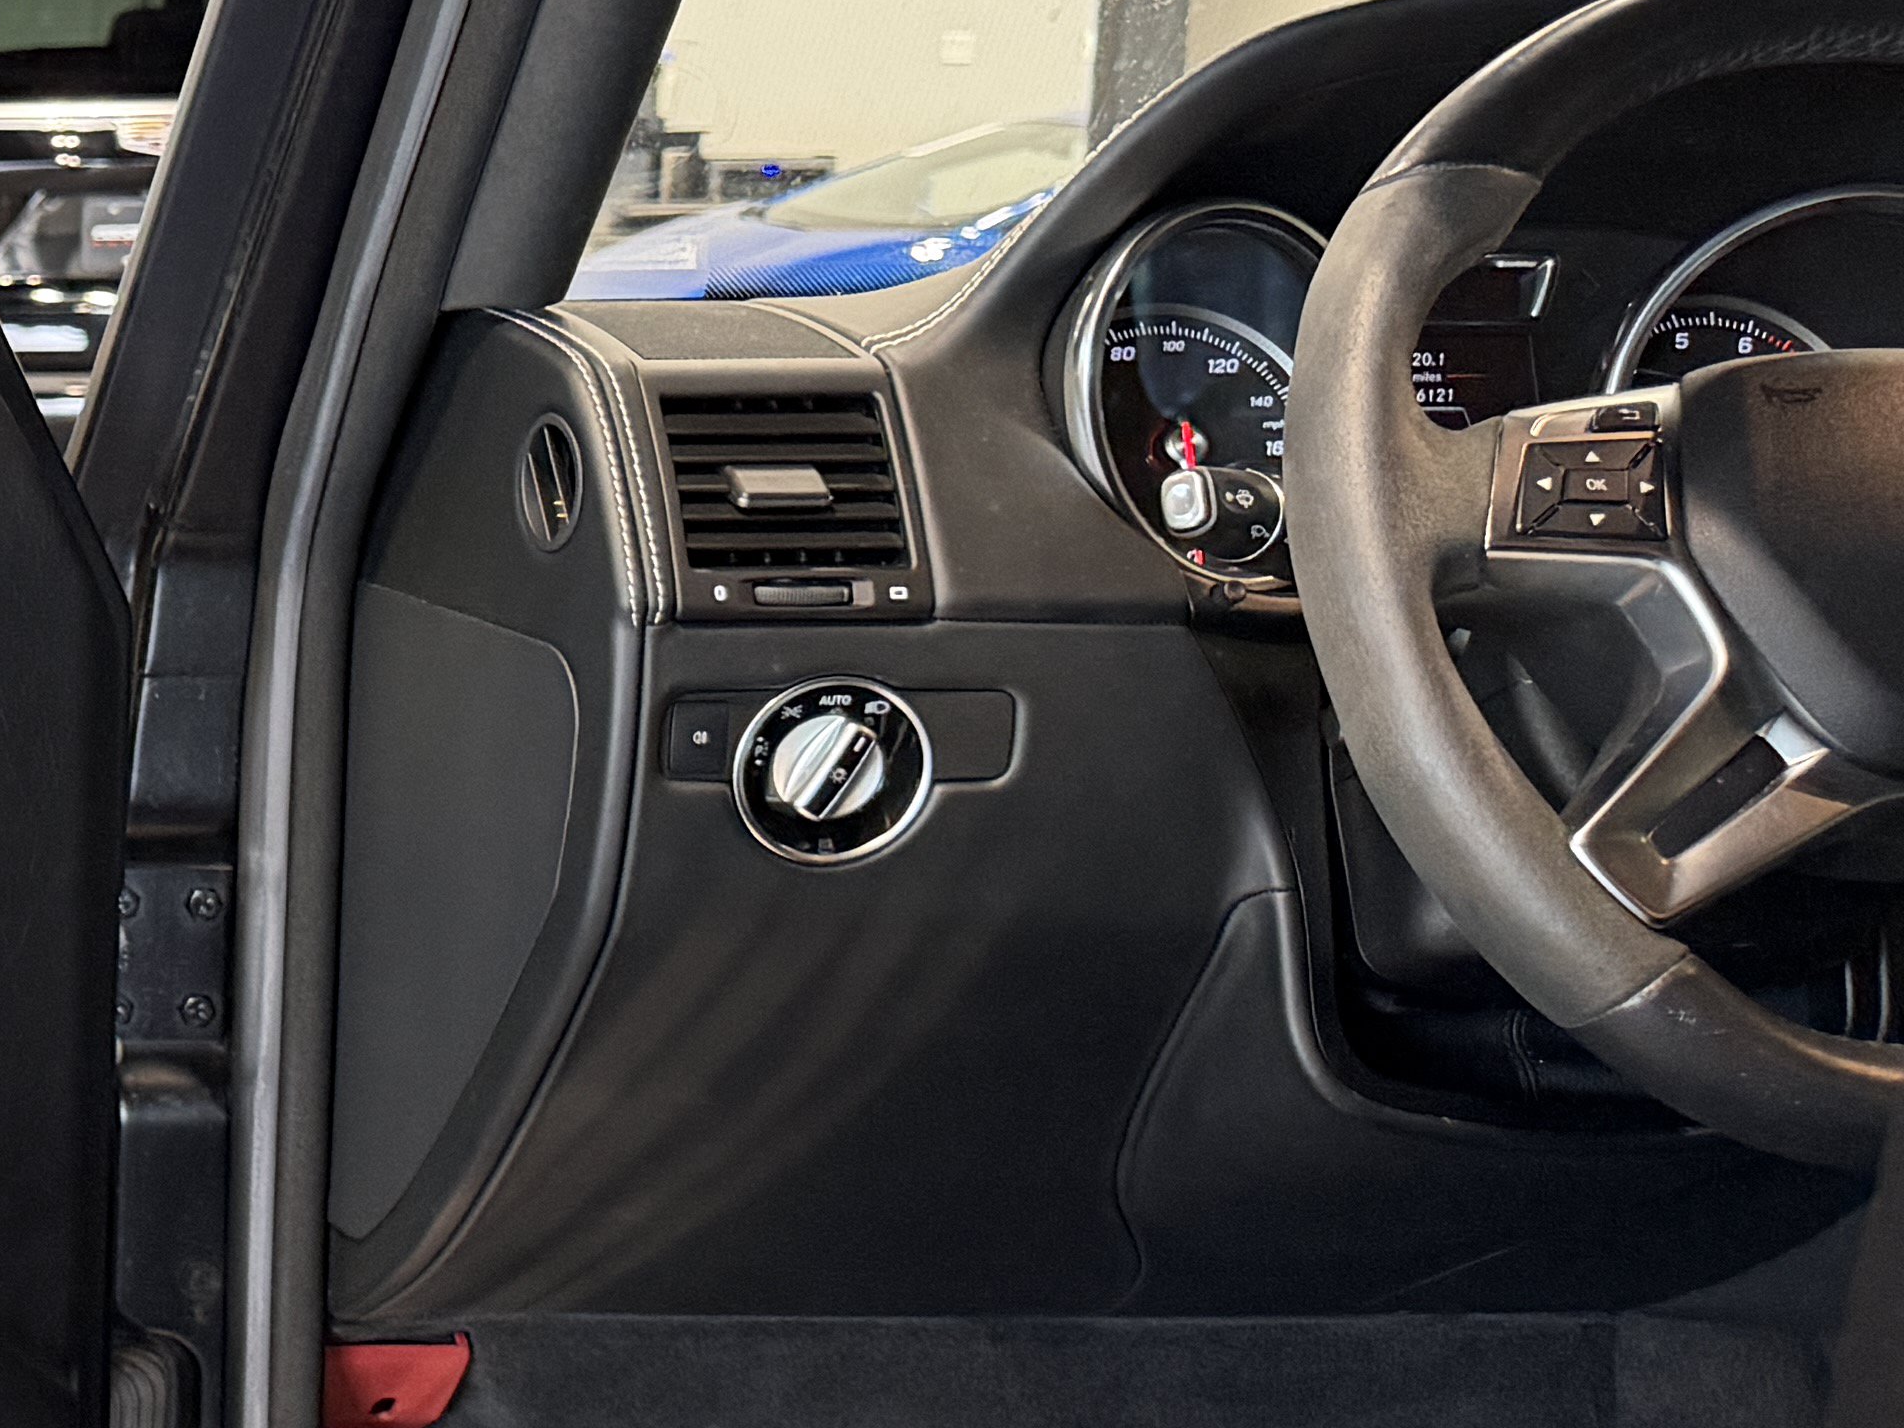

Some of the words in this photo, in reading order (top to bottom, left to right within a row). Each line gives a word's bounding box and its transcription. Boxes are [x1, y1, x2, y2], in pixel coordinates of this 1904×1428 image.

[1163, 340, 1185, 353] 100
[1674, 332, 1690, 350] 5
[1737, 337, 1753, 354] 6
[1110, 346, 1136, 362] 80
[1207, 358, 1240, 374] 120
[1412, 372, 1442, 383] miles
[1250, 395, 1274, 408] 140
[1265, 440, 1284, 456] 16
[1585, 478, 1608, 492] OK
[818, 694, 853, 706] AUTO
